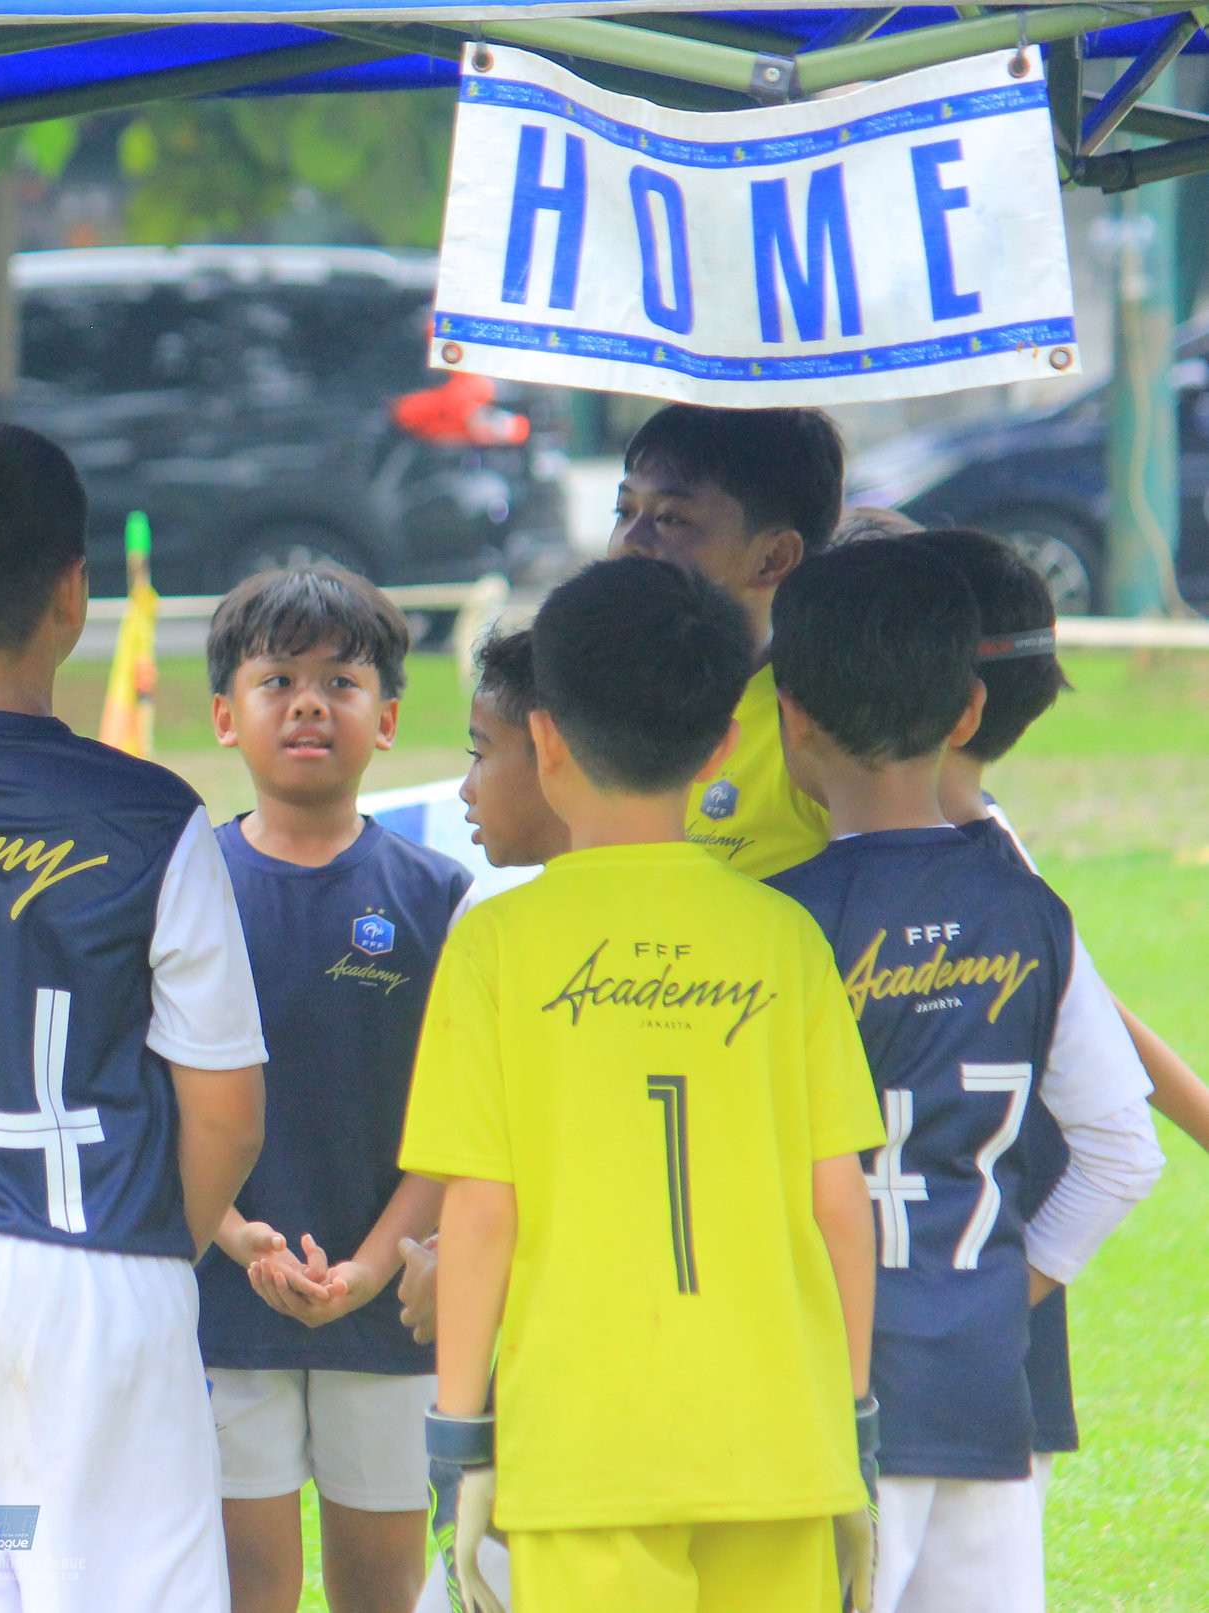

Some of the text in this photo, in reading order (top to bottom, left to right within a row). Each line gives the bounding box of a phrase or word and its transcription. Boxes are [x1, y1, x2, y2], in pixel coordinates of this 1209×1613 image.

[501, 124, 980, 344] HOME
[362, 940, 385, 949] FFF
[634, 942, 691, 959] FFF
[906, 922, 961, 945] FFF
[325, 952, 411, 996] Academy
[541, 938, 777, 1048] Academy
[843, 929, 1039, 1024] Academy
[646, 1074, 700, 1296] 1
